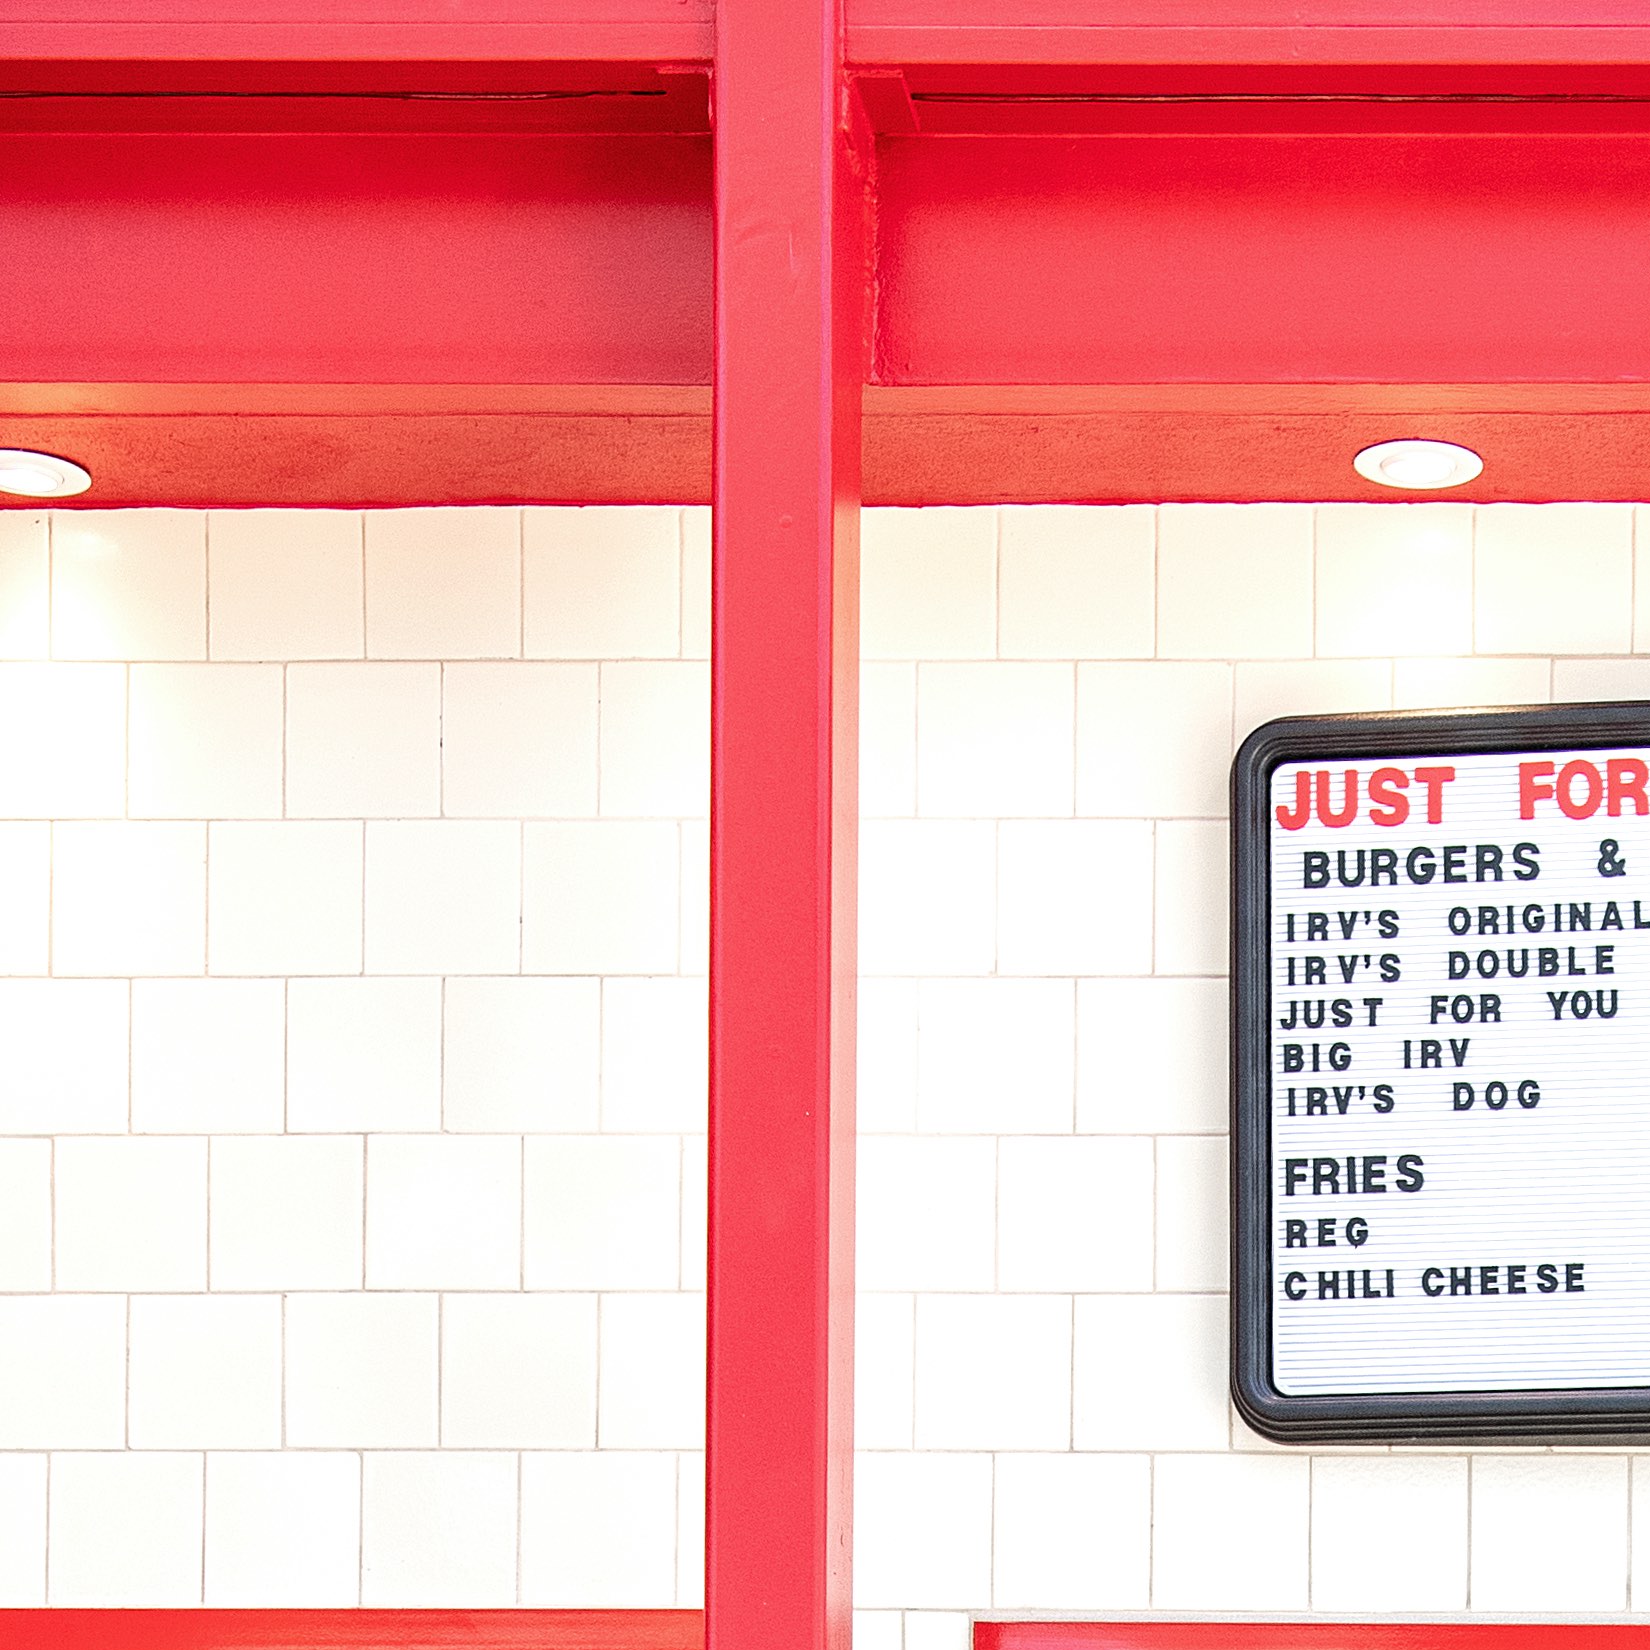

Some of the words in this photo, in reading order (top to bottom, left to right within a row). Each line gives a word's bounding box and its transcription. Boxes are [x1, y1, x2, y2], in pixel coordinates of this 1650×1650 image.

[1275, 762, 1455, 831] JUST
[1518, 758, 1649, 820] FOR
[1304, 843, 1540, 888] BURGERS
[1598, 839, 1626, 877] &
[1287, 910, 1399, 942] IRV'S
[1287, 954, 1400, 986] IRV'S
[1449, 945, 1614, 979] DOUBLE
[1280, 998, 1383, 1030] JUST
[1431, 994, 1501, 1024] FOR
[1547, 990, 1618, 1020] YOU
[1283, 1042, 1351, 1073] BIG
[1404, 1039, 1470, 1069] IRV
[1288, 1084, 1394, 1116] IRV'S
[1453, 1080, 1540, 1111] DOG
[1285, 1155, 1424, 1196] FRIES
[1286, 1217, 1368, 1248] REG
[1285, 1269, 1394, 1300] CHILI
[1422, 1264, 1584, 1297] CHEESE
